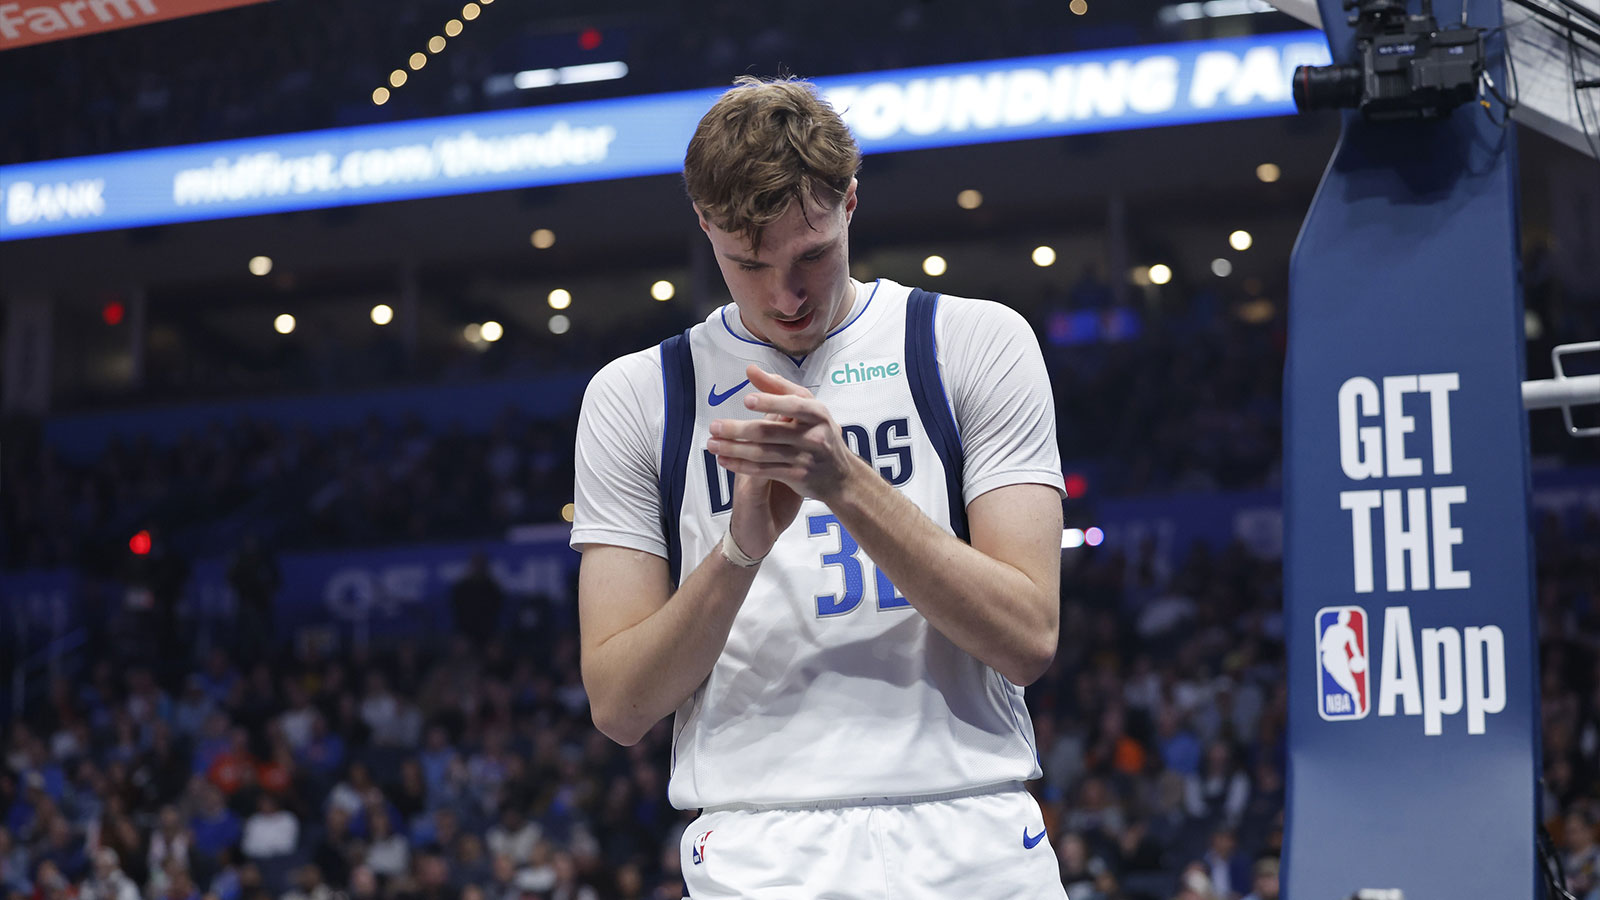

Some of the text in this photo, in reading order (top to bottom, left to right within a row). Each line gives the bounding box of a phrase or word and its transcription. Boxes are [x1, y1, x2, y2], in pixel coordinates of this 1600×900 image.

[0, 0, 158, 40] Farm
[831, 362, 900, 385] chime
[1338, 372, 1460, 481] GET
[1340, 485, 1471, 593] THE
[1325, 693, 1352, 714] NBA
[1378, 605, 1507, 736] App
